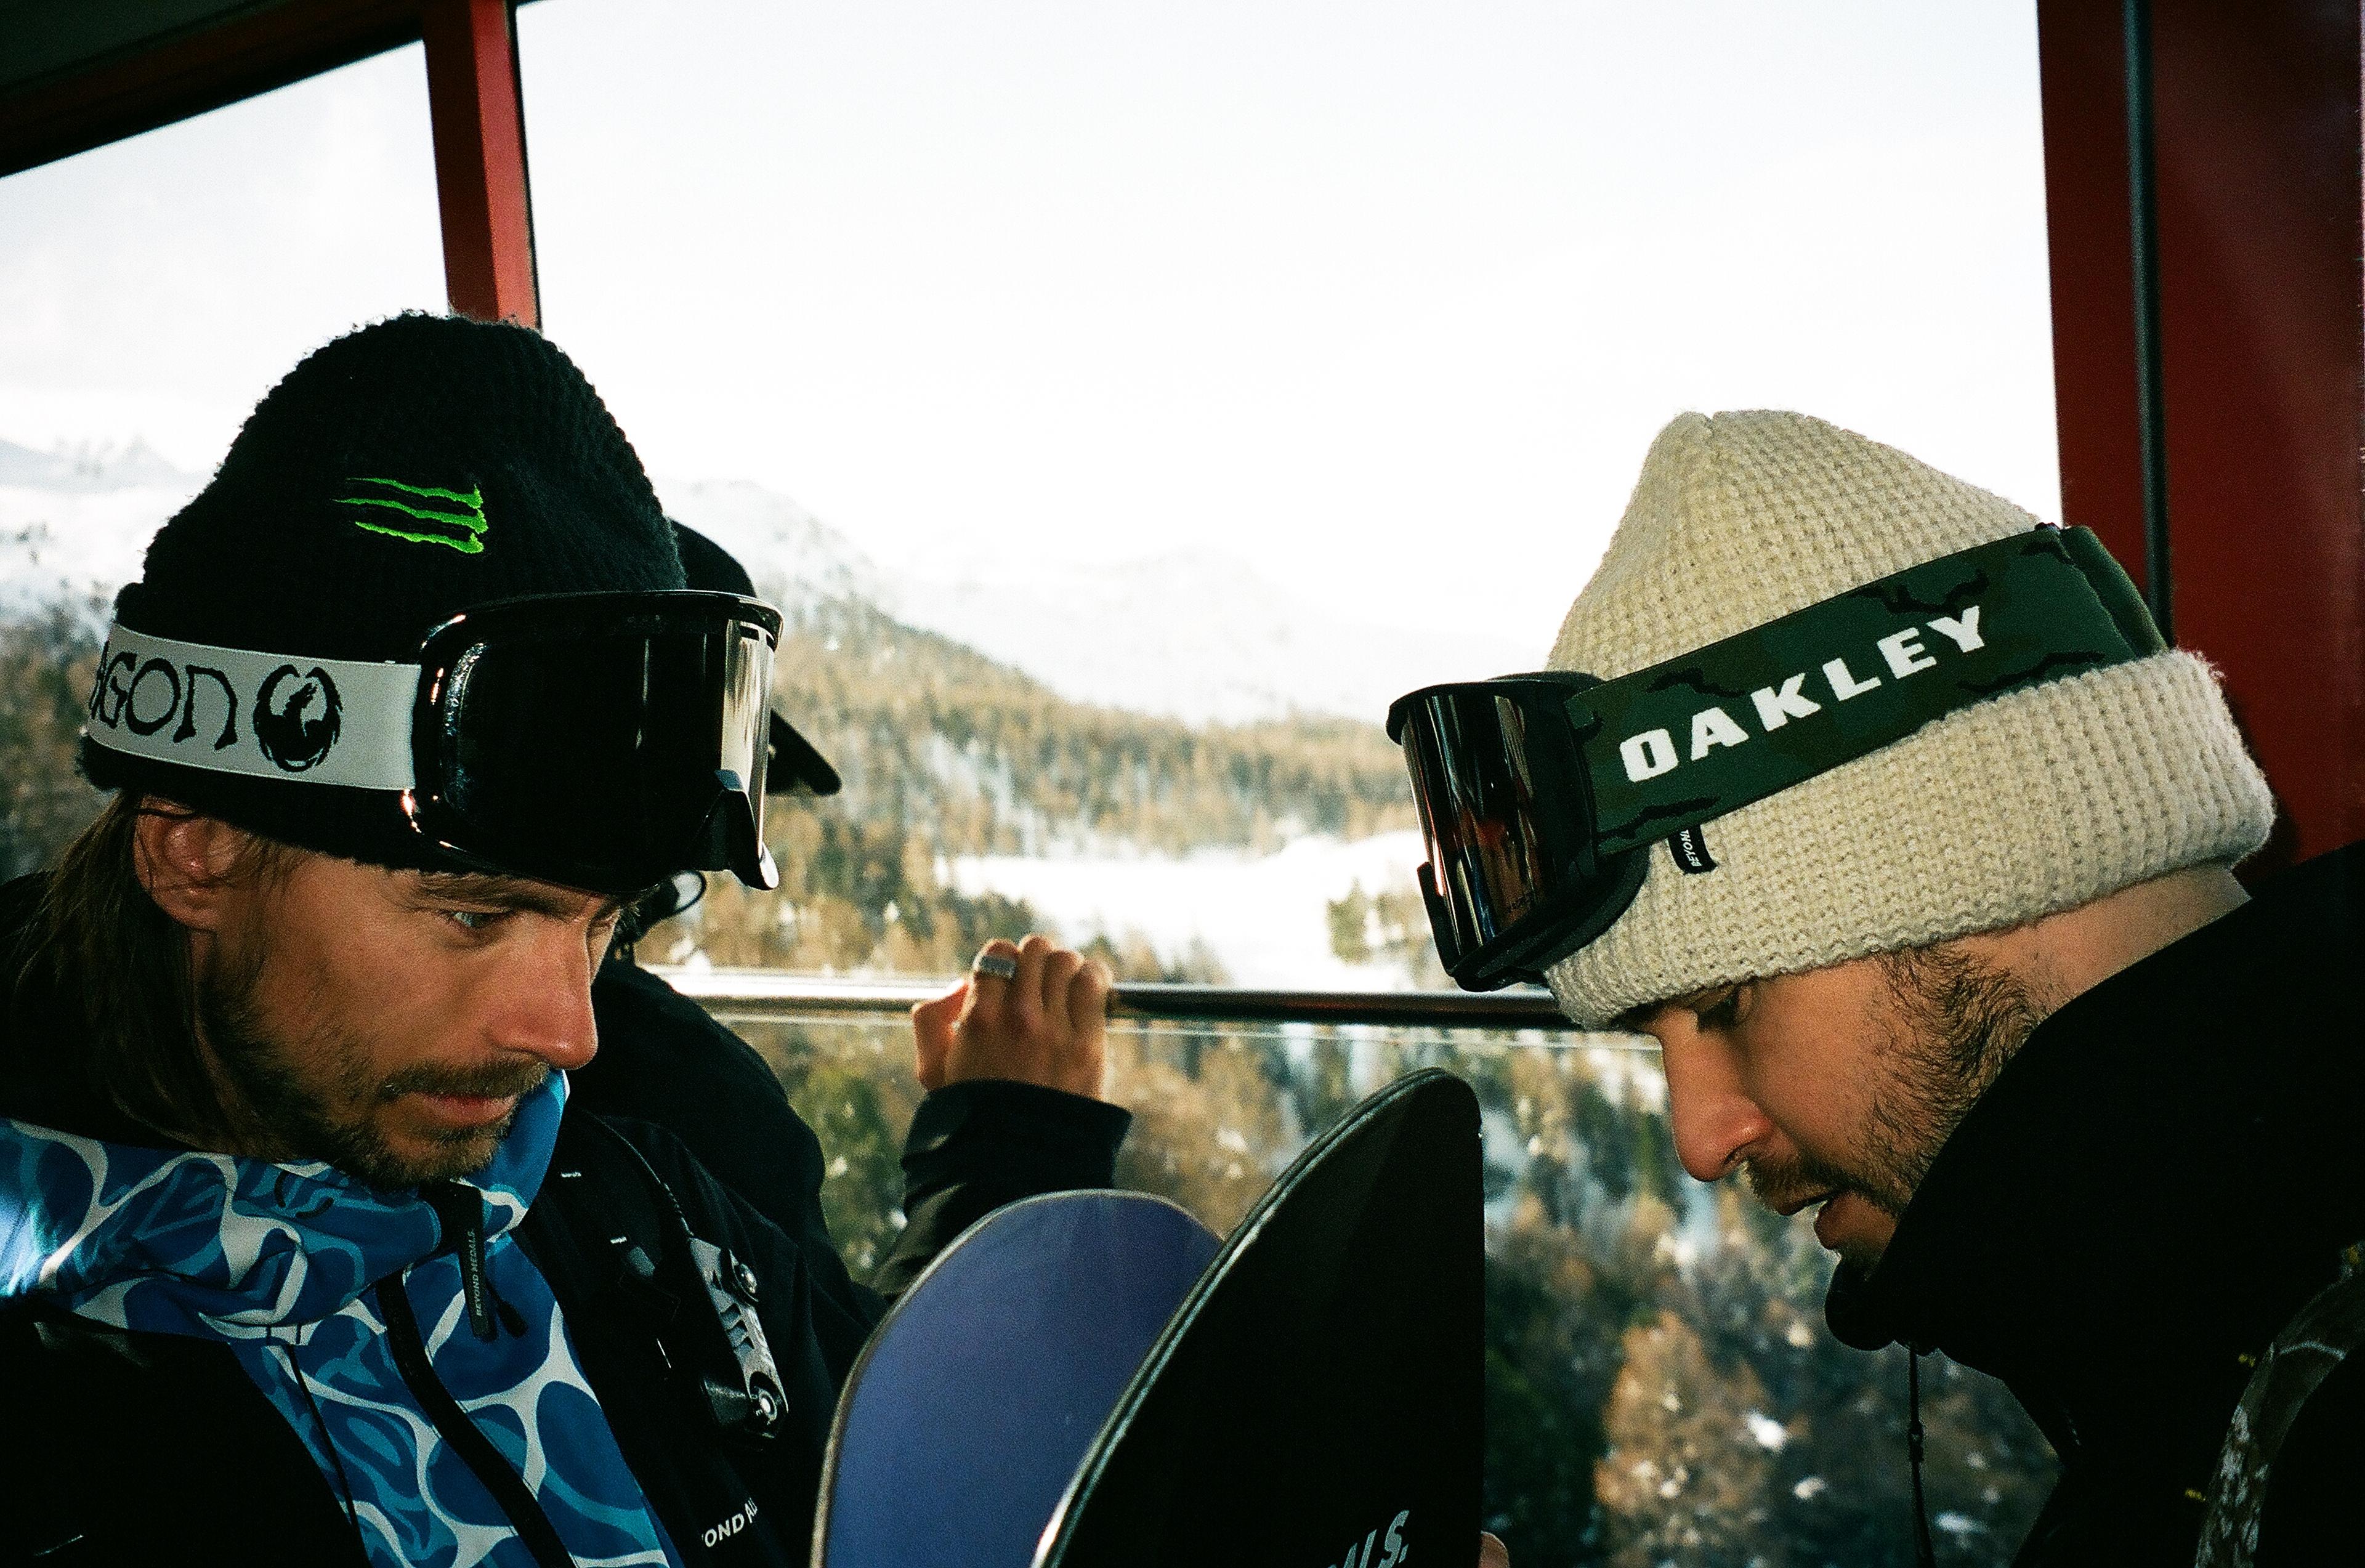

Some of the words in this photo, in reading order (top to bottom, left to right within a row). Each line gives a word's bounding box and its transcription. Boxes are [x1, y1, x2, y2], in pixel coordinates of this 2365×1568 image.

[1619, 605, 1984, 782] OAKLEY
[472, 1274, 482, 1317] BEYOND
[701, 1513, 745, 1548] OND
